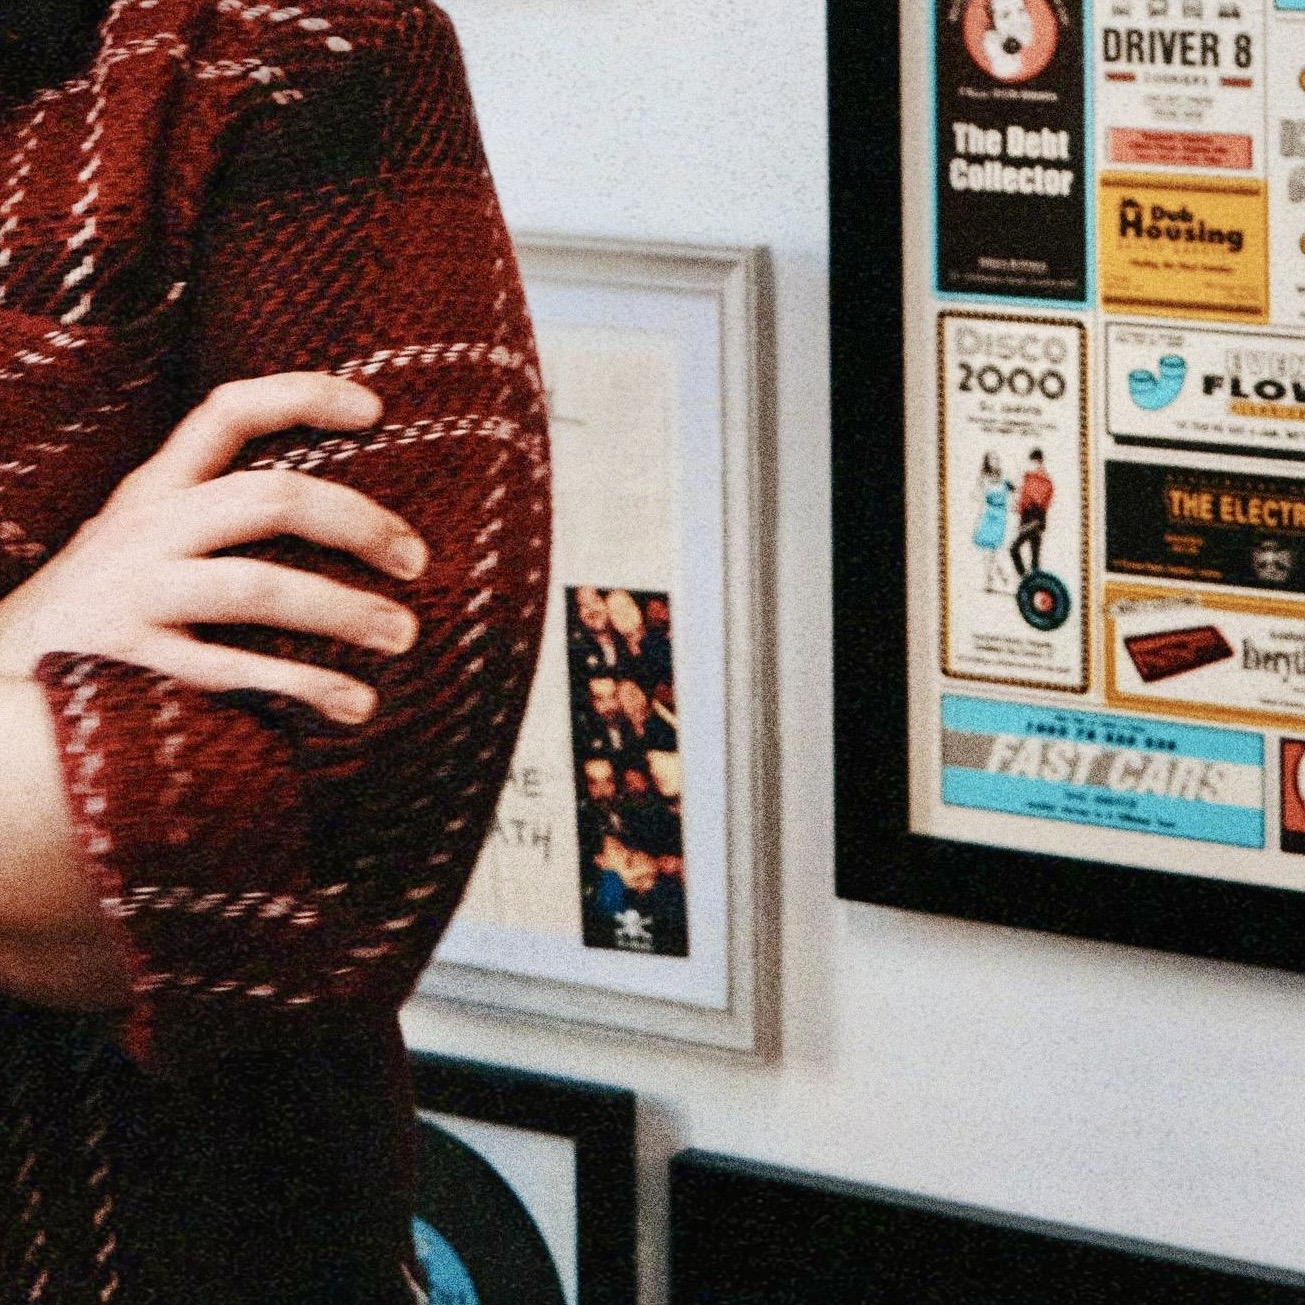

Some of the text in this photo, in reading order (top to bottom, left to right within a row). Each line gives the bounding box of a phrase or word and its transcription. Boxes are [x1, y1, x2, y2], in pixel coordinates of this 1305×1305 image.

[1102, 27, 1253, 69] DRIVER 8
[951, 121, 1072, 163] The Debt
[947, 157, 1076, 198] Collector
[1118, 198, 1244, 254] Housing
[1150, 204, 1194, 224] Dub
[954, 324, 1068, 365] DISCO
[957, 360, 1068, 400] 2000
[1166, 486, 1214, 521] THE
[987, 732, 1103, 788] FAST
[1106, 747, 1227, 802] CARS
